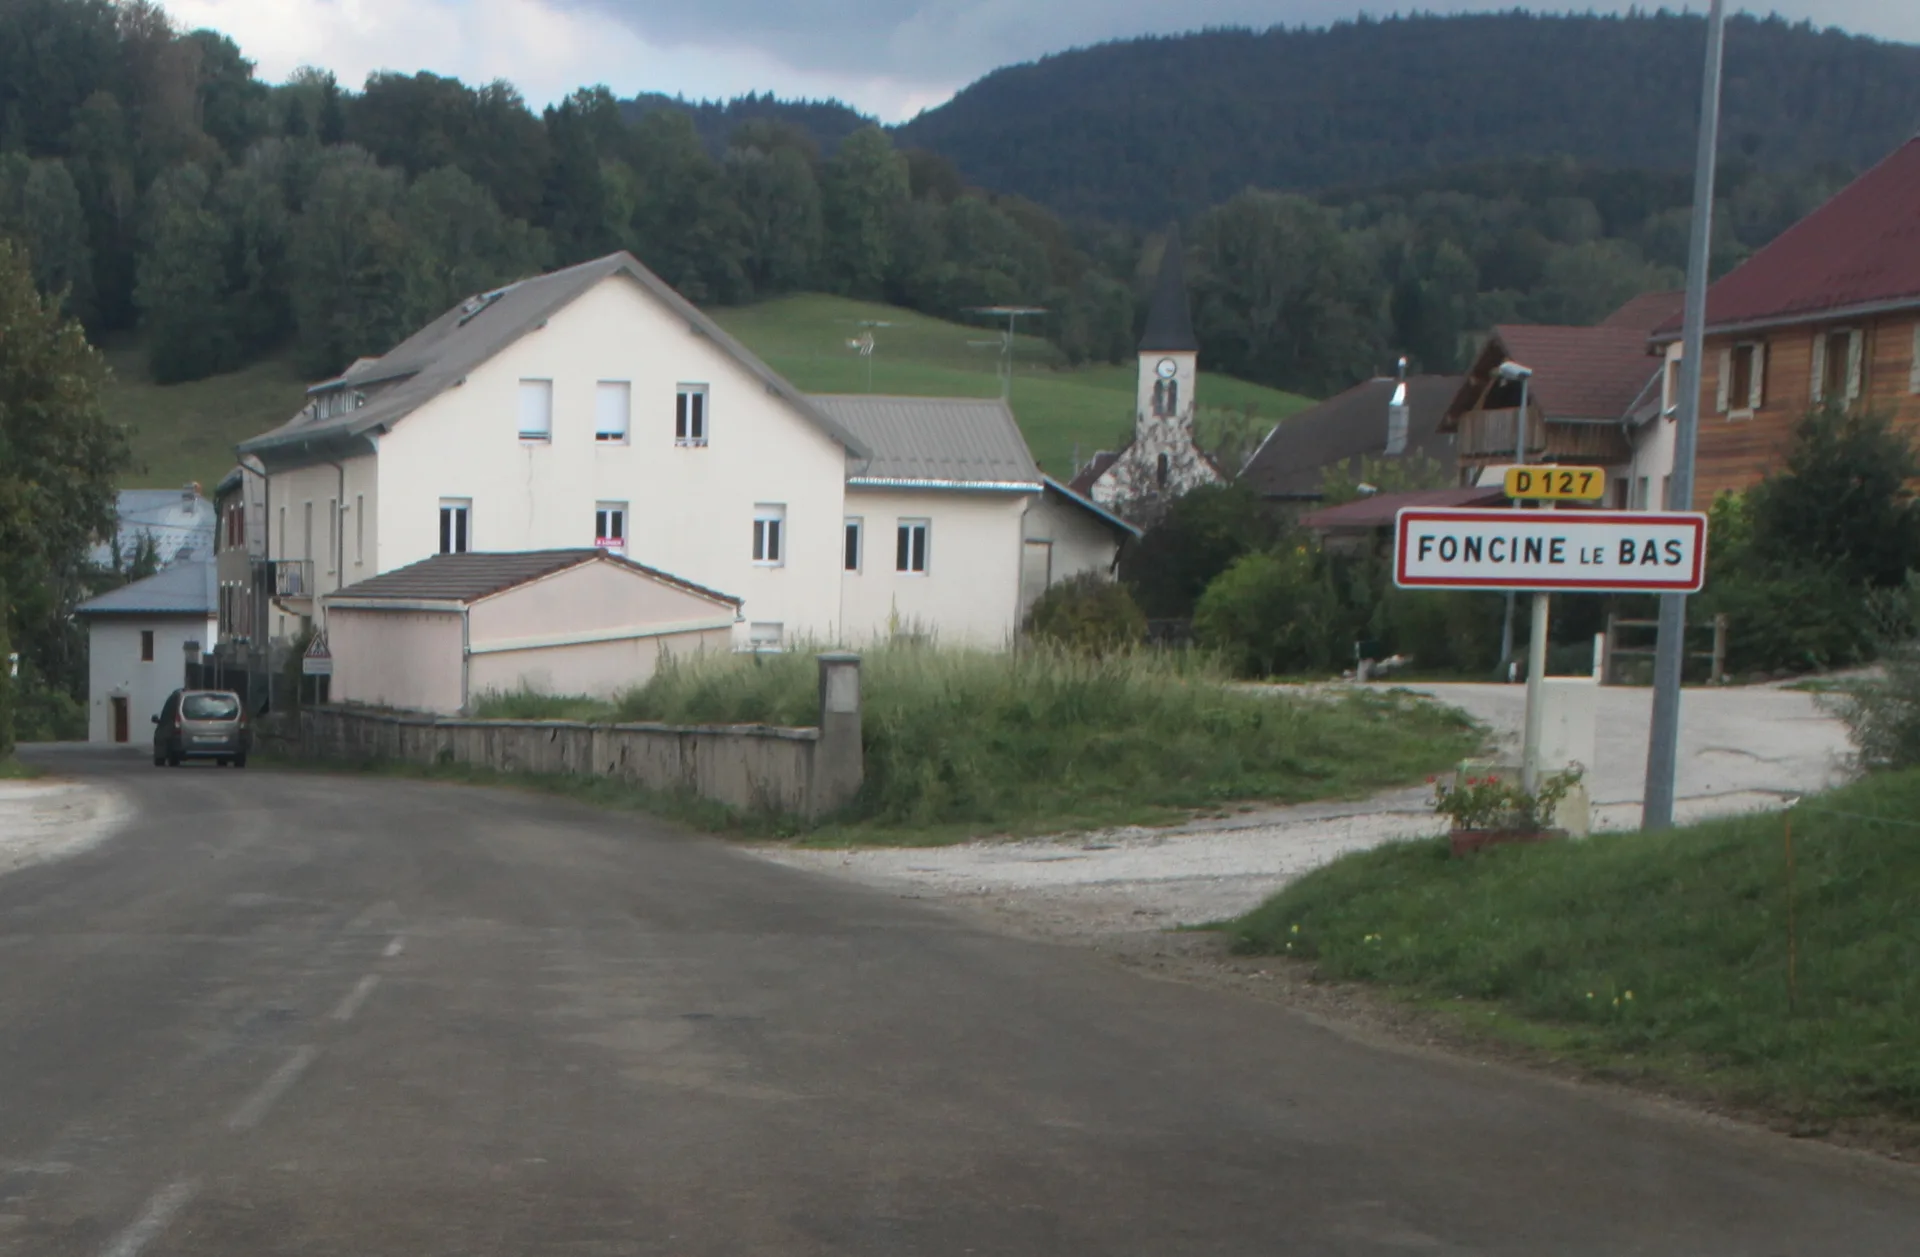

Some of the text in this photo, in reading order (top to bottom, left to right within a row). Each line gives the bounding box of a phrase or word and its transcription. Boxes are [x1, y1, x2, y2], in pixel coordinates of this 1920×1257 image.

[1516, 472, 1594, 494] D 127
[1418, 535, 1683, 566] FONCINE LE BAS
